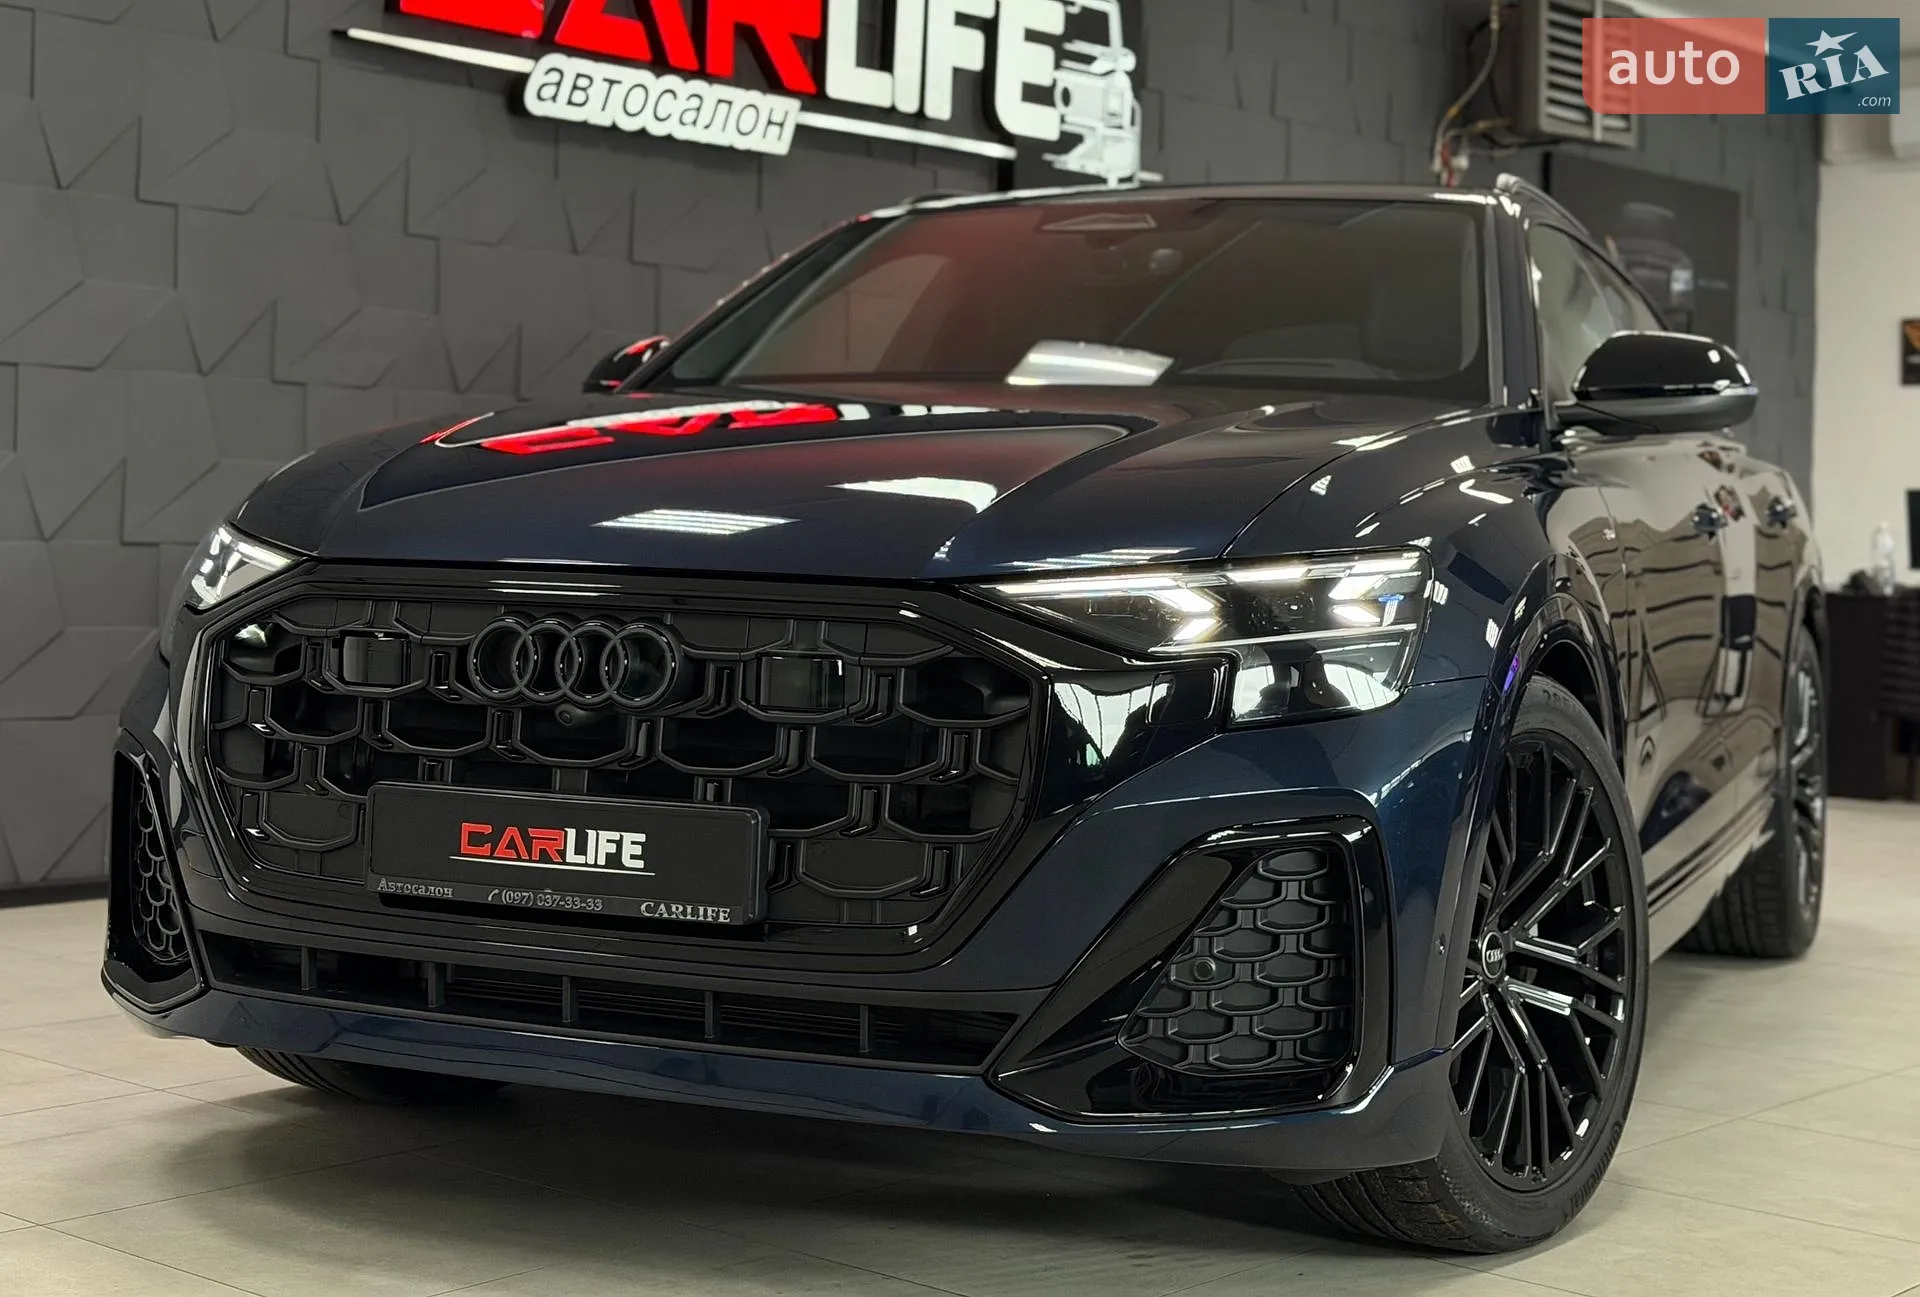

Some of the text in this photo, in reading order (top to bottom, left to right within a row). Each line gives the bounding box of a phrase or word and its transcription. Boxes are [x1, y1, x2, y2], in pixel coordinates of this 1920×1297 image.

[535, 66, 790, 142] автосалон
[460, 822, 647, 869] CARLIFE
[377, 877, 454, 899] Автосалон
[501, 888, 604, 911] (097) 037-33-33
[640, 901, 732, 924] CARLIFE
